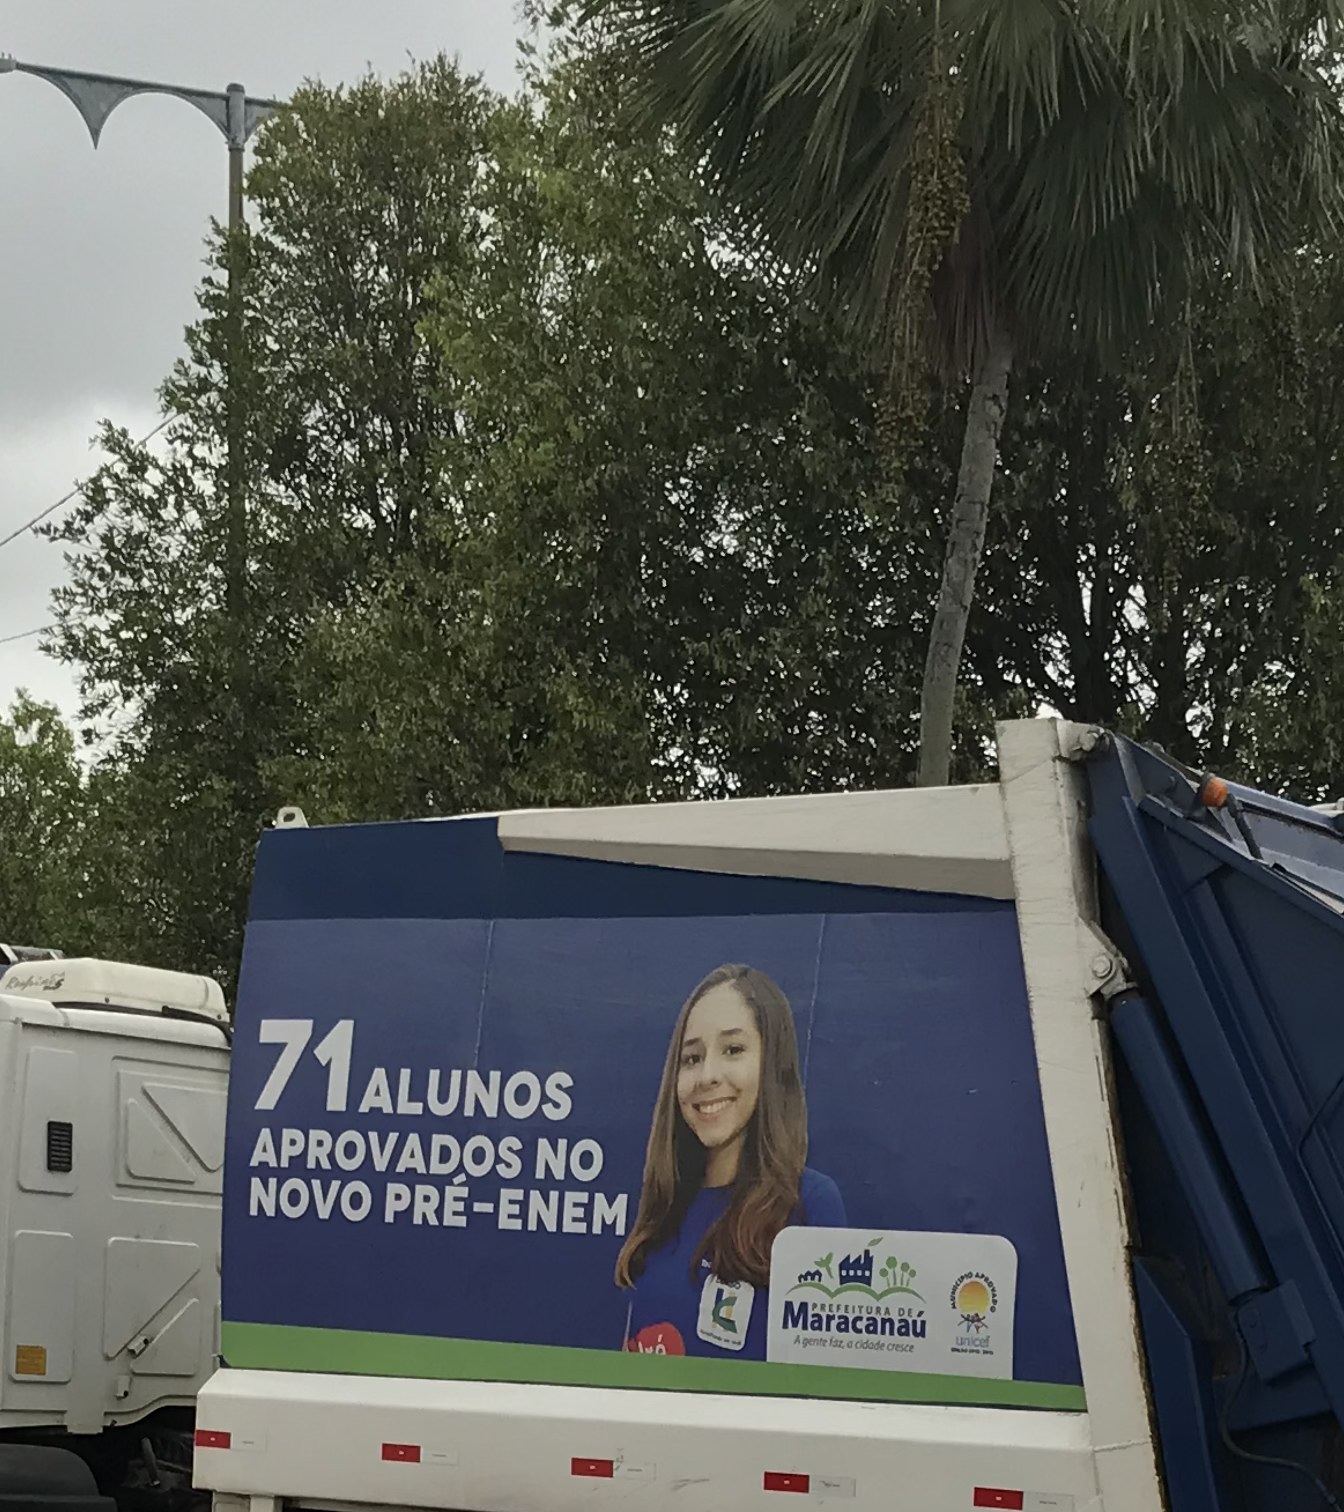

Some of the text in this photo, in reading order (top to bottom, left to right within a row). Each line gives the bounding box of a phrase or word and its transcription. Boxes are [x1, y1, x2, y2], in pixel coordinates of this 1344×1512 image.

[254, 1019, 574, 1121] 71 ALUNOS
[249, 1128, 603, 1182] APROVADOS NO
[249, 1173, 628, 1236] NOVO PRÉ-ENEM
[811, 1302, 913, 1318] PREFEITURA DE
[975, 1272, 998, 1313] APROVADO
[782, 1300, 926, 1339] Maracanaú
[794, 1335, 914, 1353] A gente faz, a cidade cresce
[956, 1335, 990, 1348] unicef
